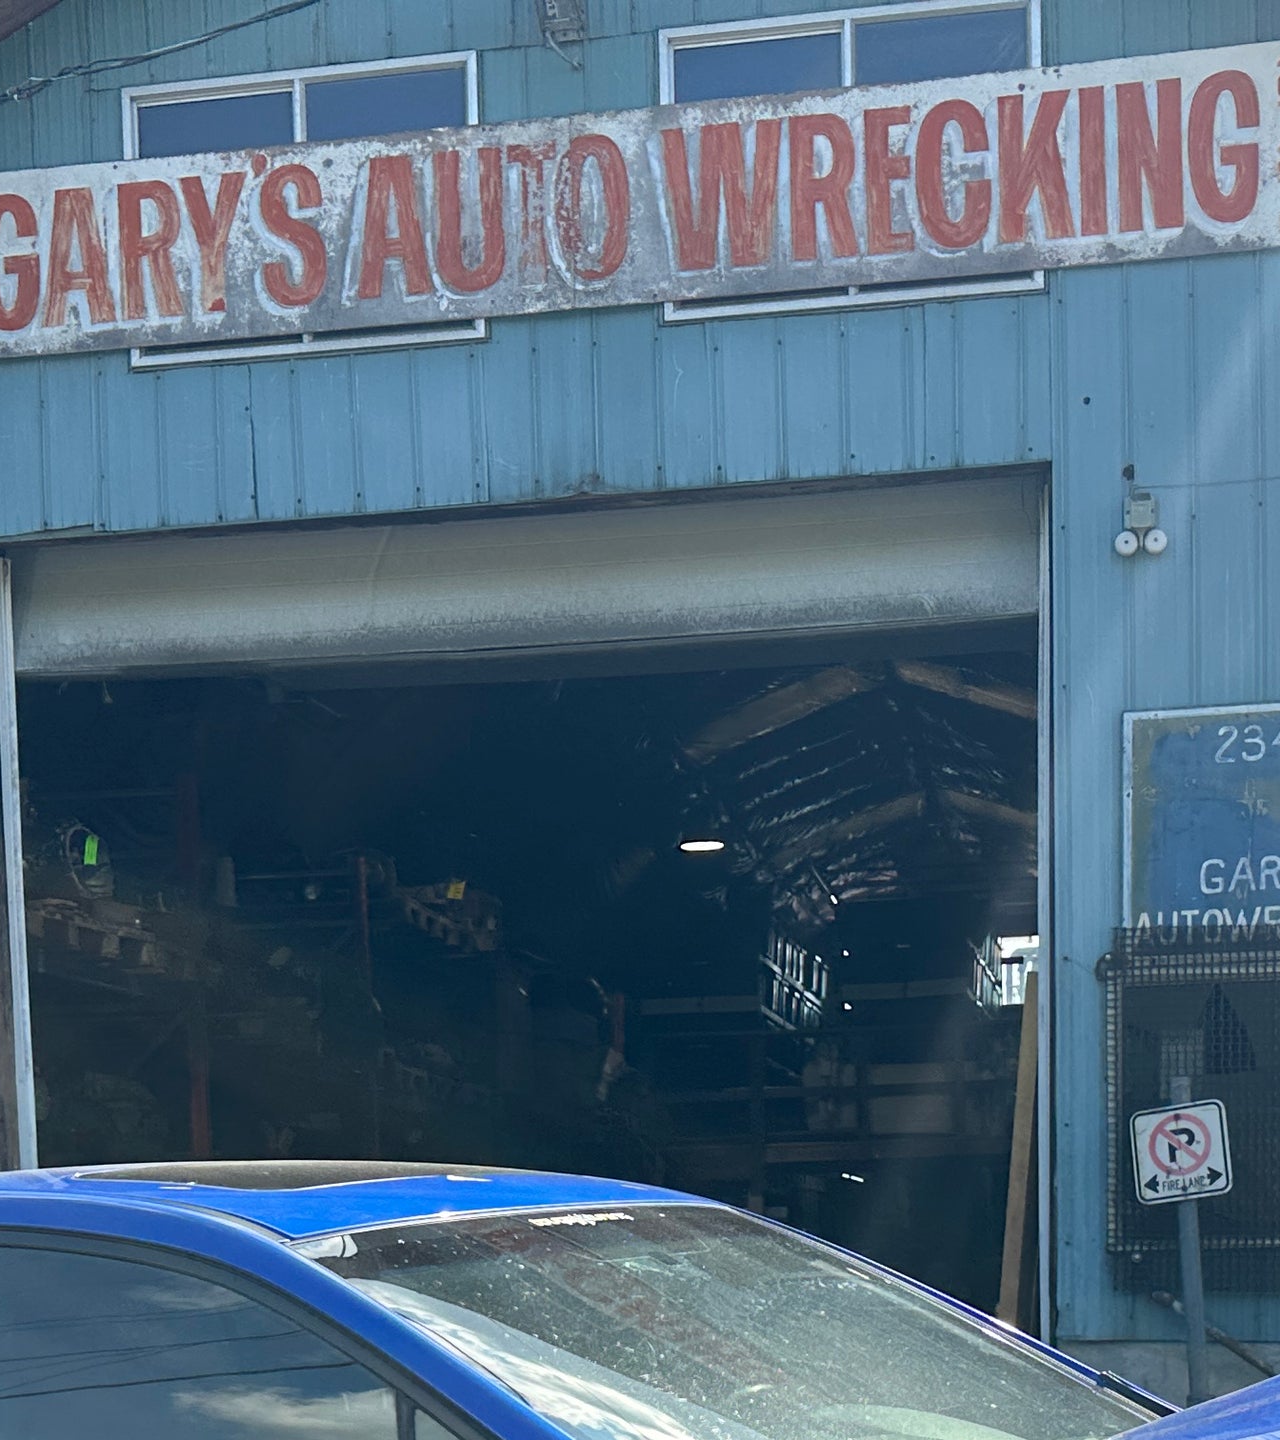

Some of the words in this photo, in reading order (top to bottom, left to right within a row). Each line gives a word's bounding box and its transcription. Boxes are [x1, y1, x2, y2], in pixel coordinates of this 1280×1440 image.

[356, 133, 631, 300] AUTO
[660, 69, 1261, 271] WRECKING
[1161, 1179, 1183, 1192] FIRE
